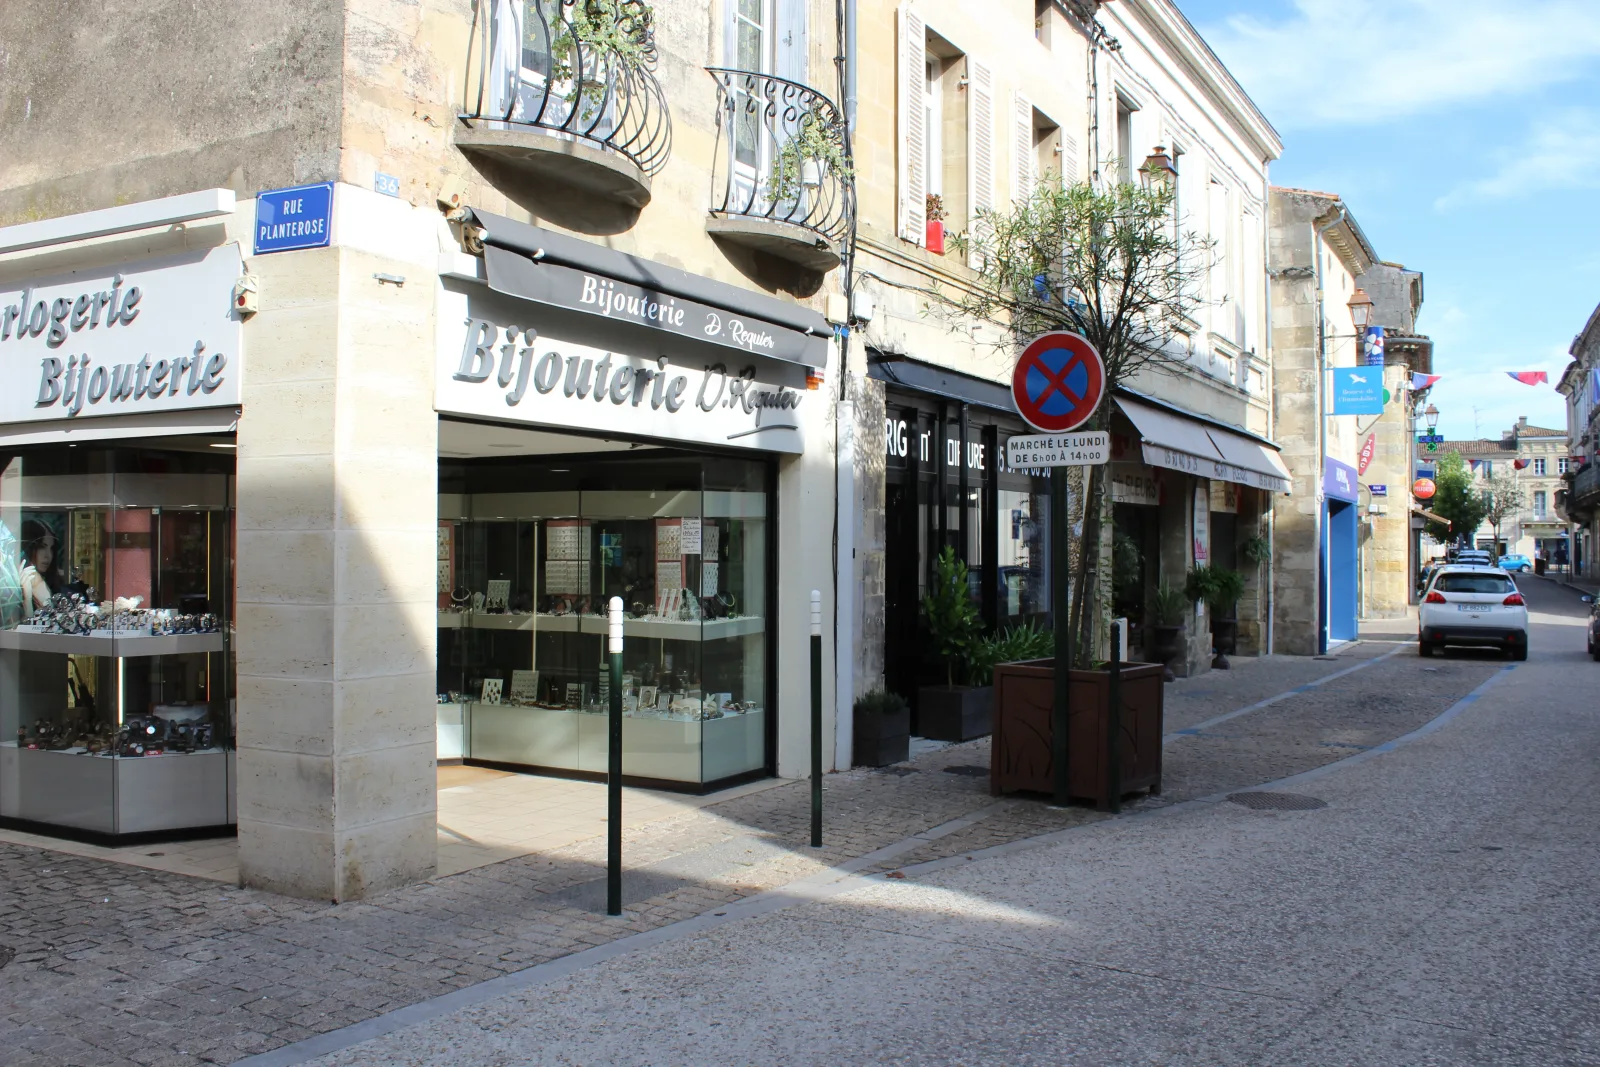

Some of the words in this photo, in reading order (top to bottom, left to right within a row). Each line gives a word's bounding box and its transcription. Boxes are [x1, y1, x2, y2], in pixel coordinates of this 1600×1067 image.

[379, 176, 396, 193] 36
[283, 198, 303, 216] RUE
[260, 218, 324, 241] PLANTEROSE
[0, 272, 144, 345] rlogerie
[580, 275, 685, 328] Bijouterie
[704, 313, 726, 337] D.
[727, 319, 775, 350] Requier
[34, 339, 229, 417] Bijouterie
[452, 316, 688, 415] Bijouterie
[1010, 438, 1054, 451] MARCHÉ
[1057, 439, 1069, 448] LE
[1073, 437, 1105, 447] LUNDI
[1015, 454, 1028, 463] DE
[1032, 453, 1057, 462] 6h00
[1060, 450, 1066, 460] À
[1071, 451, 1101, 461] 14h00
[1360, 439, 1373, 468] TABAC
[1126, 474, 1156, 499] FLEURS
